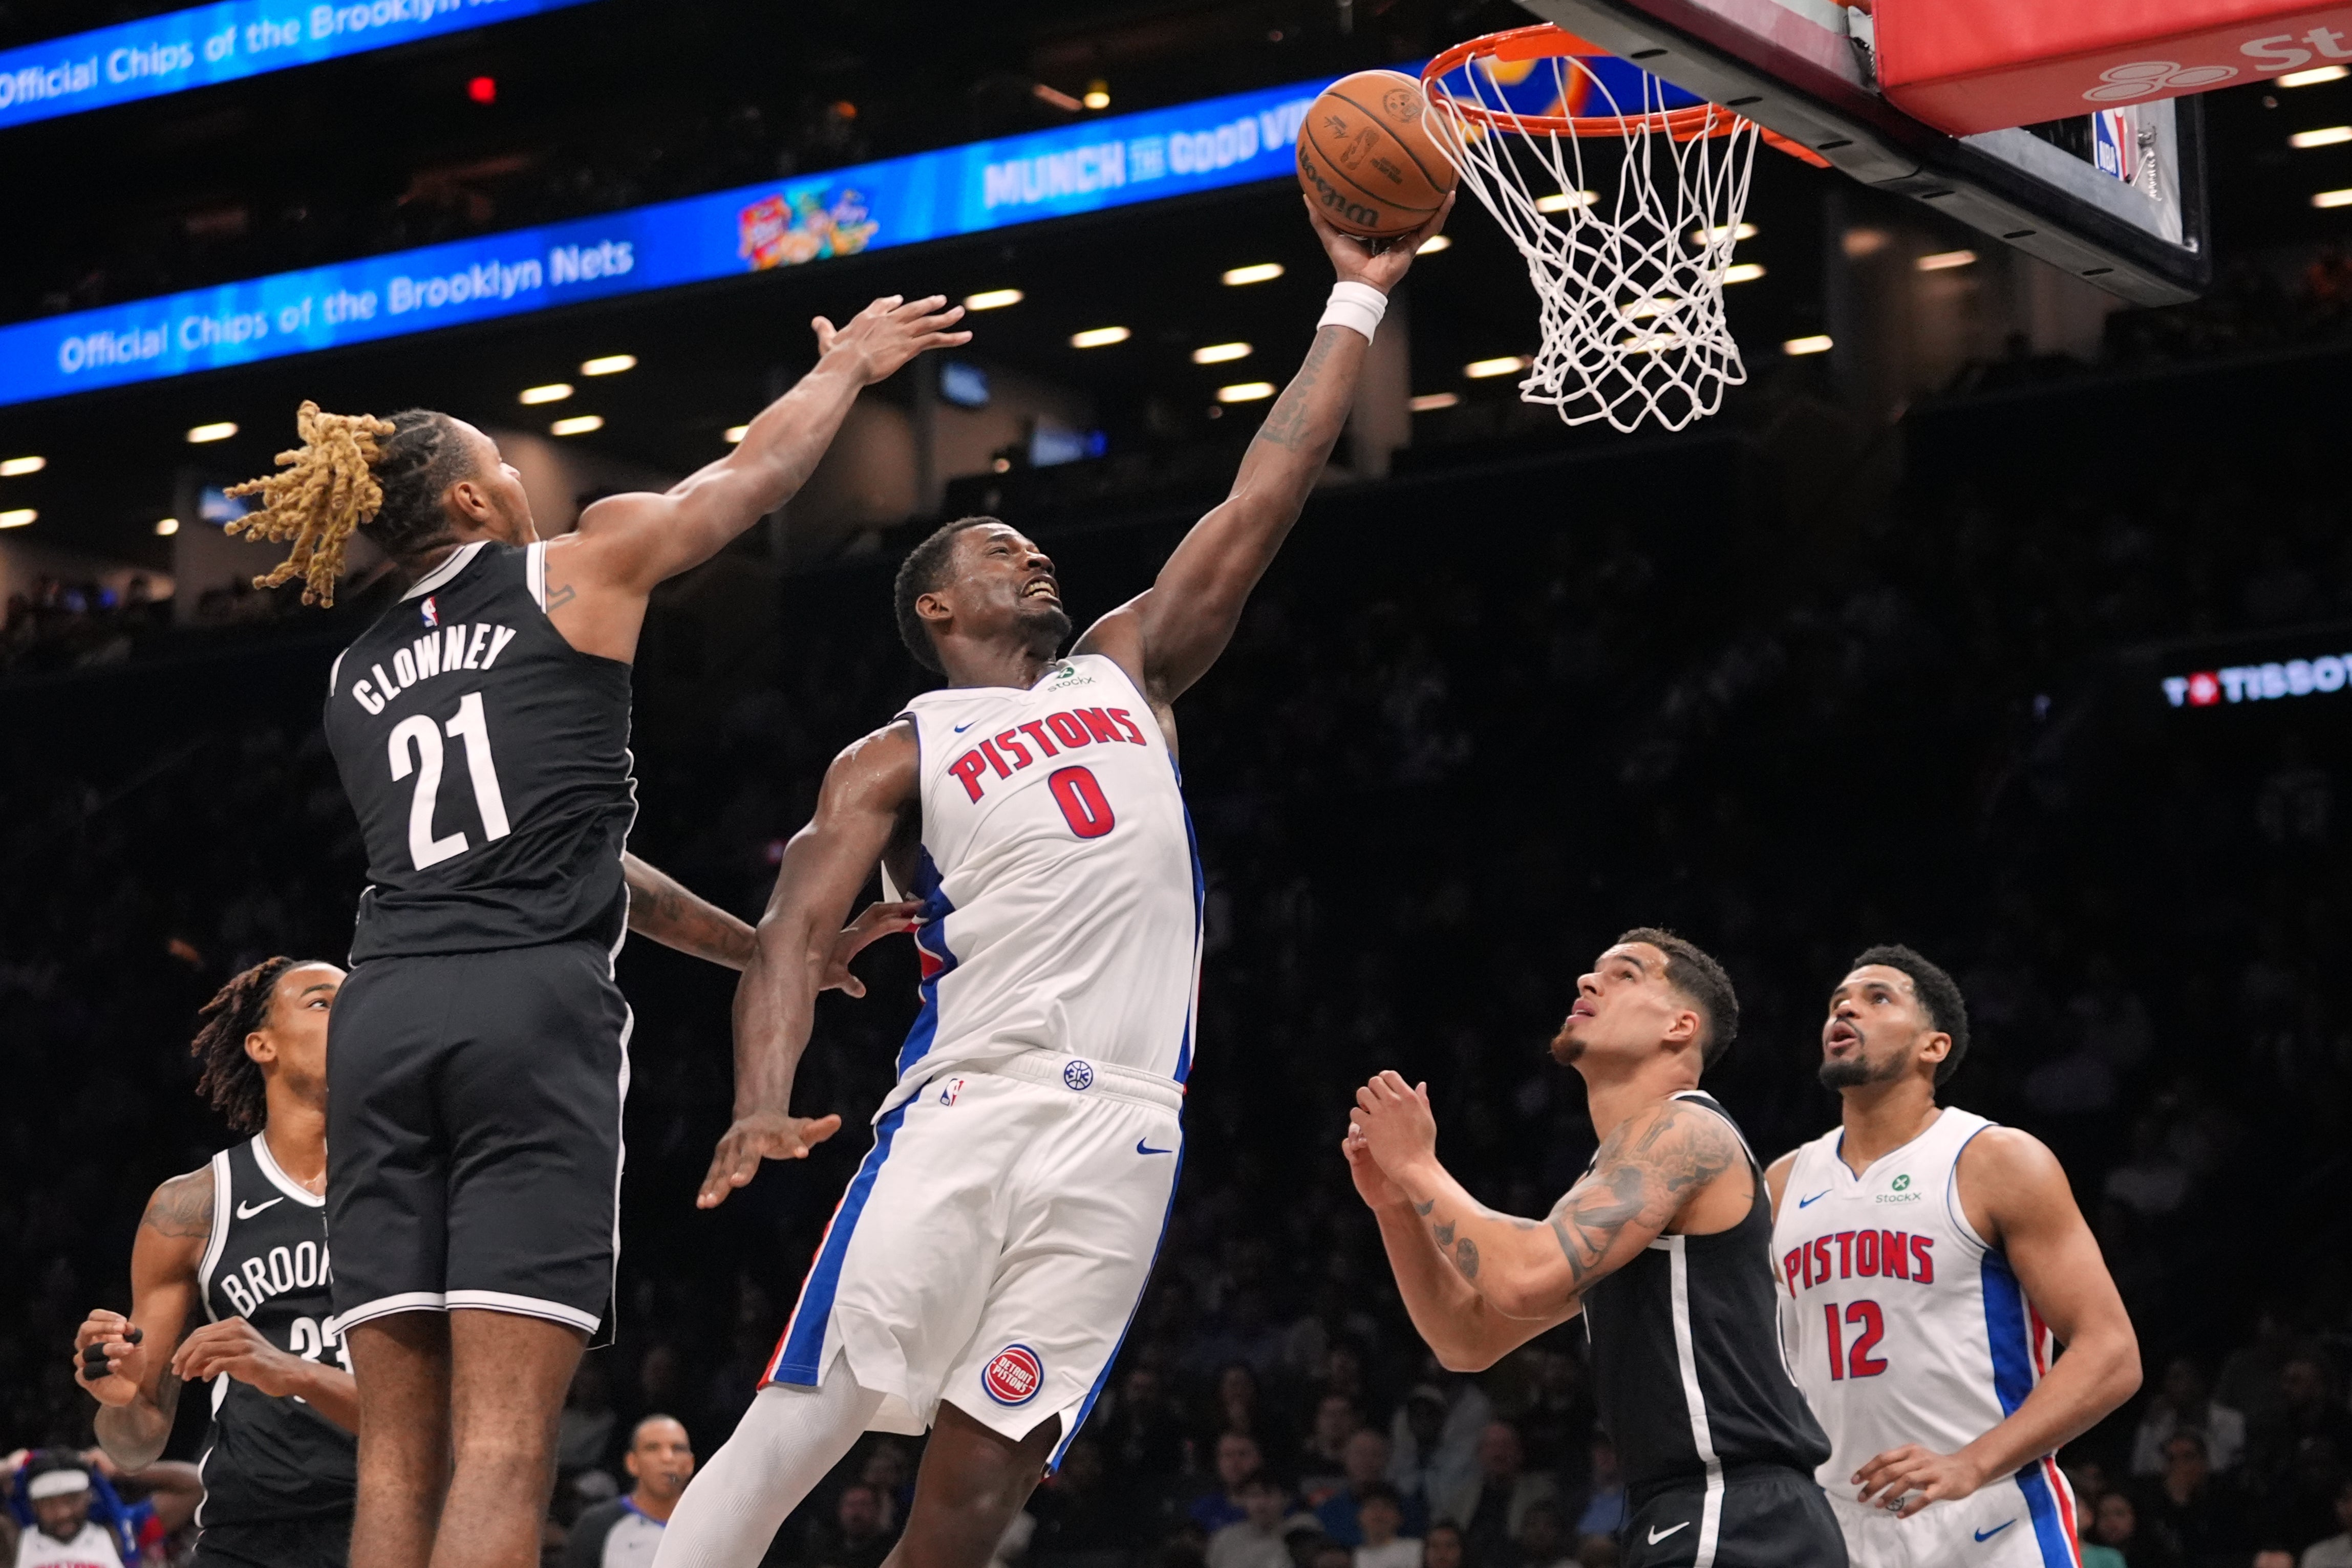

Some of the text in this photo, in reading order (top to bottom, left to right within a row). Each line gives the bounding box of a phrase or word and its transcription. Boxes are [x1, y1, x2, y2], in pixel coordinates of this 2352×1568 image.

[106, 41, 195, 83] Chips
[206, 26, 237, 61] of
[246, 17, 301, 52] the
[985, 142, 1125, 209] MUNCH
[1169, 116, 1259, 175] GOOD
[1299, 142, 1379, 228] Wilson
[59, 240, 634, 373] Official Chips of the Brooklyn Nets
[352, 622, 517, 715] CLOWNEY
[388, 691, 511, 871] 21
[948, 707, 1147, 805] PISTONS
[1048, 765, 1115, 839] 0
[1875, 1192, 1922, 1203] StockX
[1784, 1229, 1934, 1299] PISTONS
[992, 1364, 1029, 1393] PISTONS
[999, 1356, 1034, 1384] DETROIT
[1824, 1299, 1888, 1381] 12
